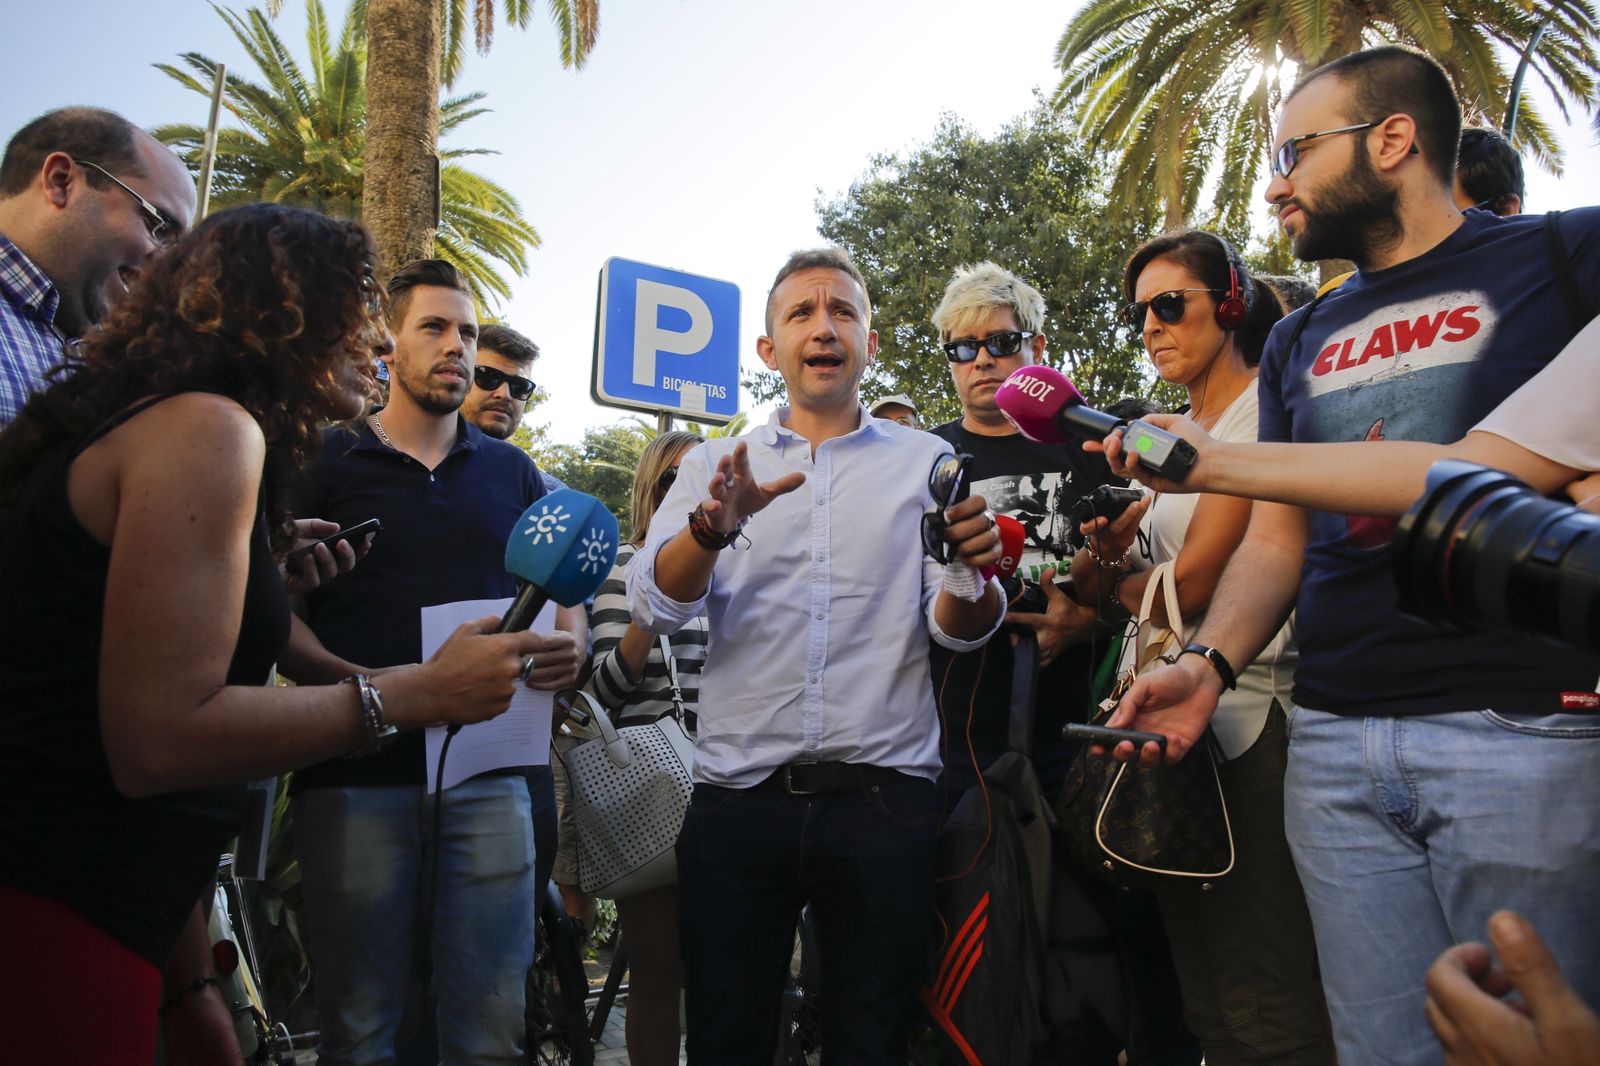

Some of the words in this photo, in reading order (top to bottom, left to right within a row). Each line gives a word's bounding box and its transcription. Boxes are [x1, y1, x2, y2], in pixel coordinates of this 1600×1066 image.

[633, 278, 713, 387] P
[1311, 305, 1481, 377] CLAWS
[990, 480, 1015, 491] Clash
